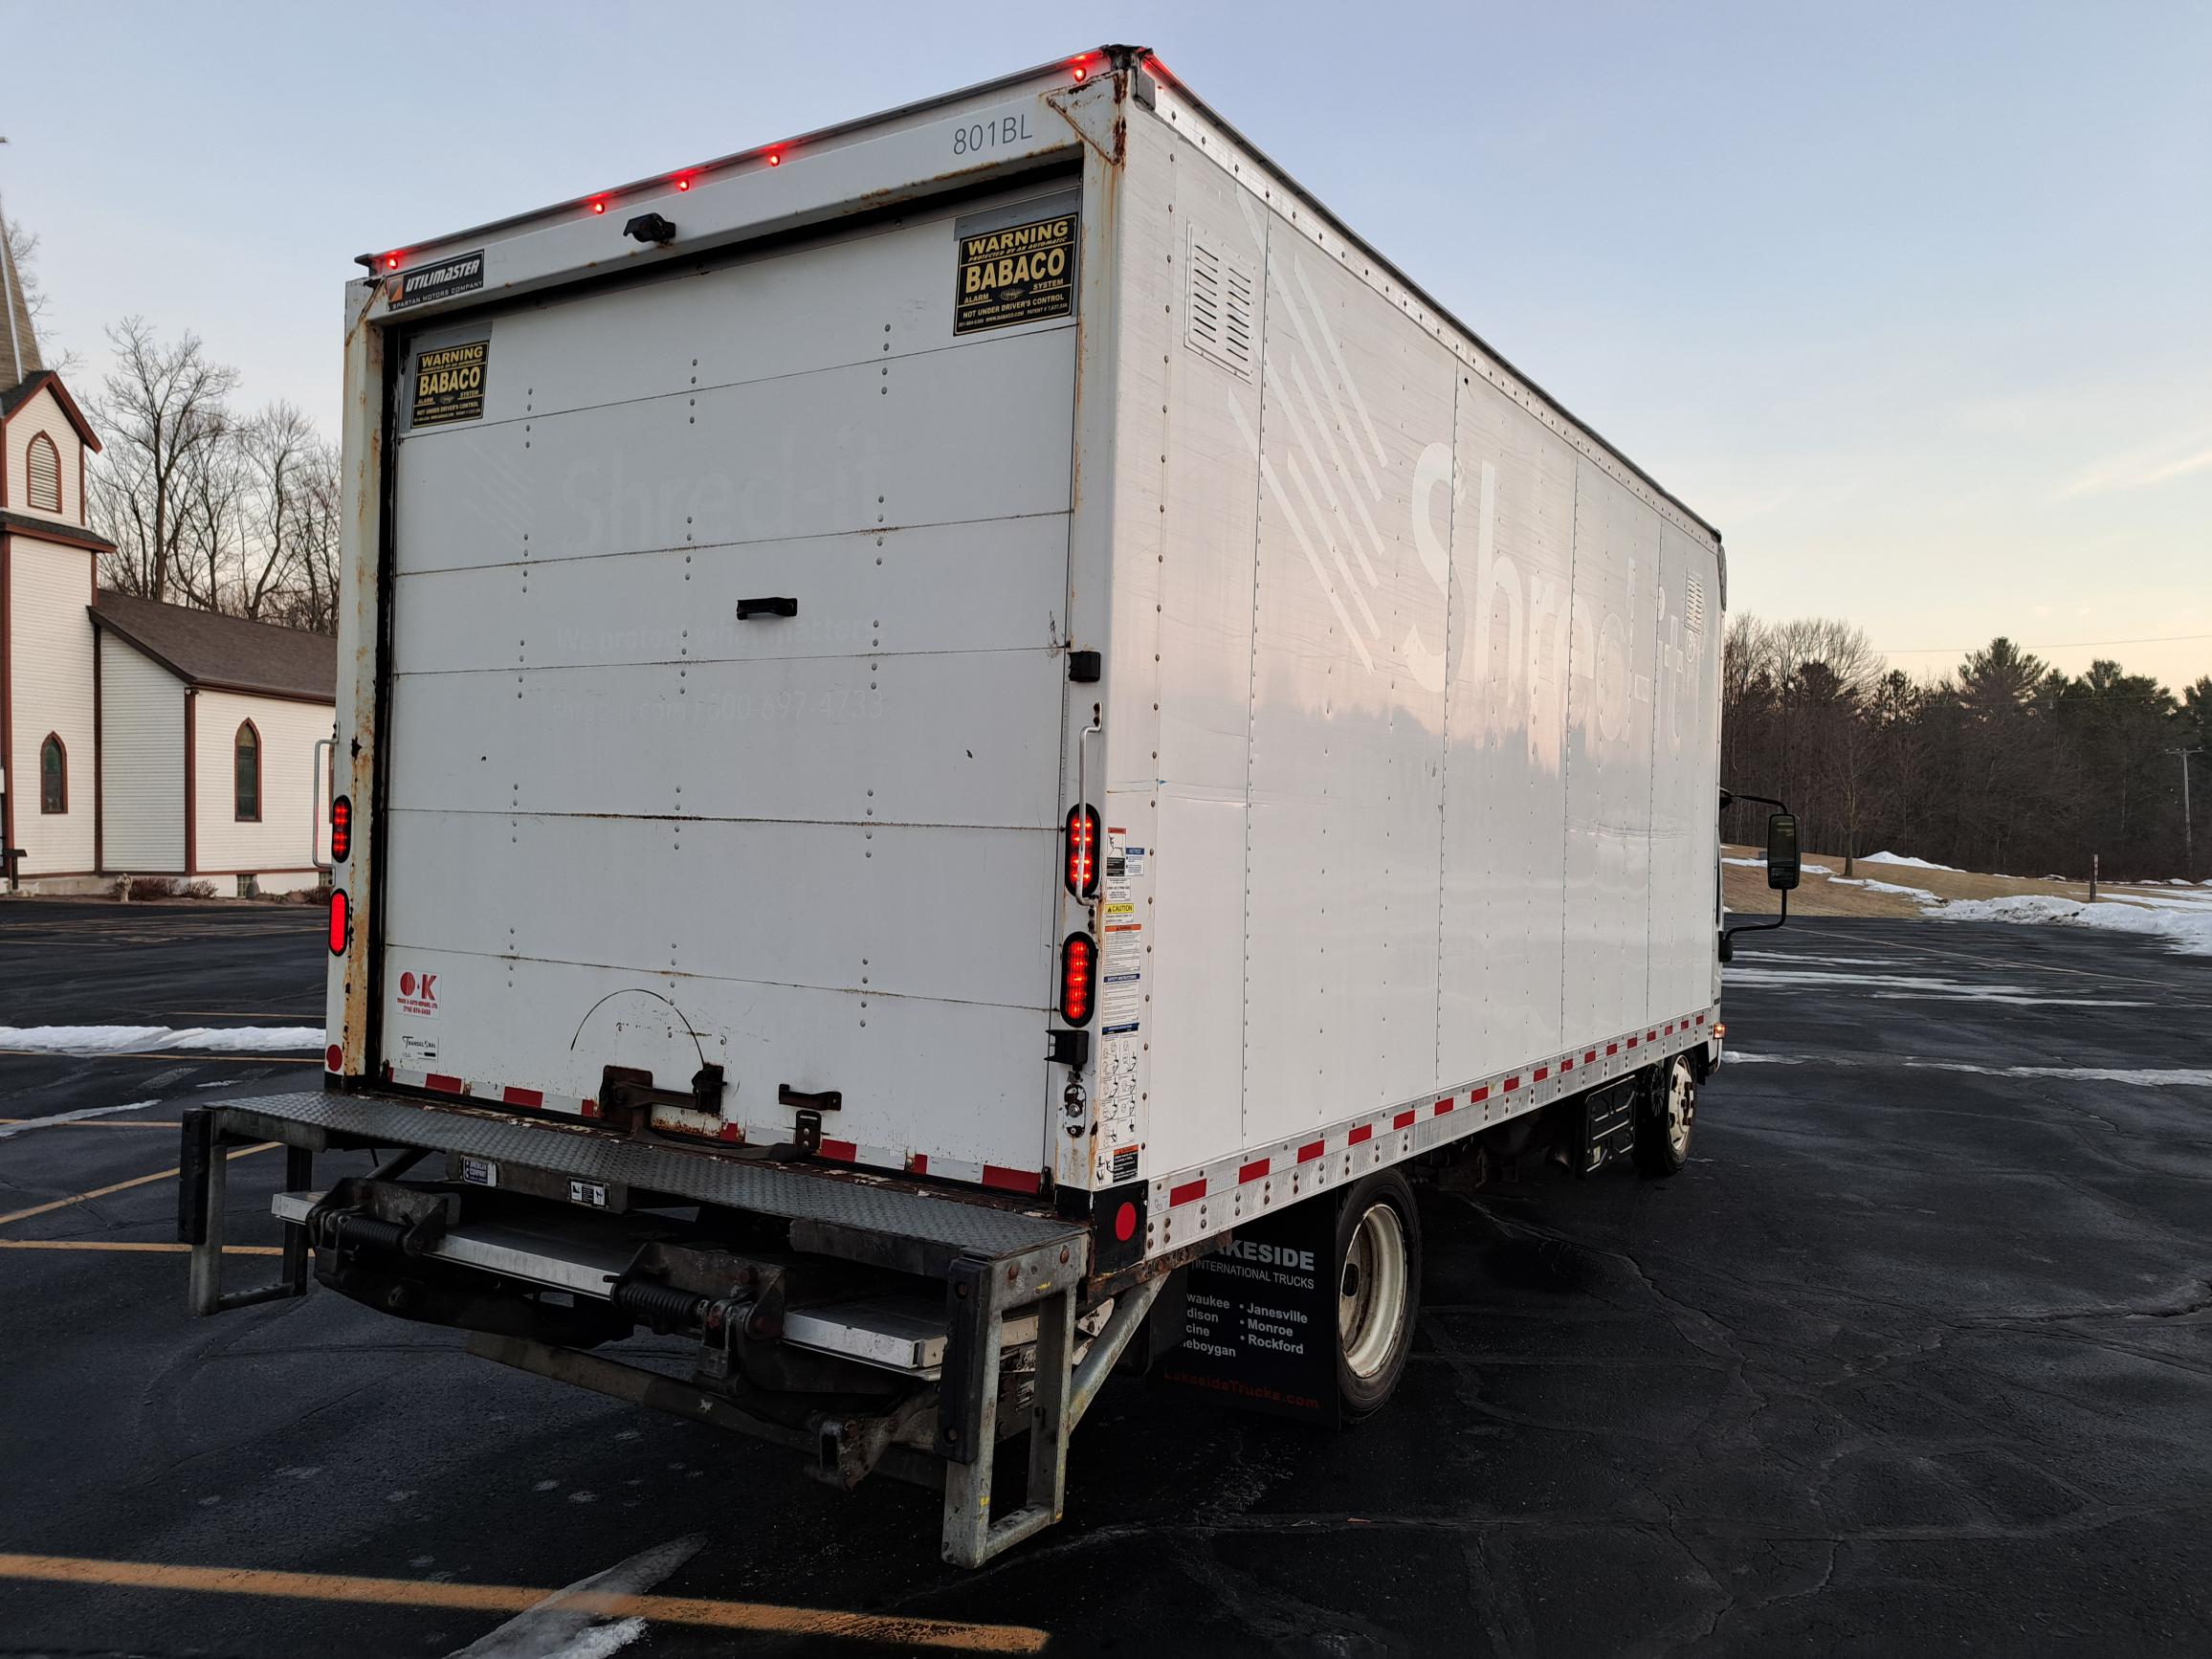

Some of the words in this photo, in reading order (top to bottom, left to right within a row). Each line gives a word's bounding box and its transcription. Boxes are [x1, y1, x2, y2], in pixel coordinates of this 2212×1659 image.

[954, 114, 1032, 154] 801BL
[968, 221, 1068, 255] WARNING
[405, 258, 480, 293] UTILIMASTER
[965, 247, 1066, 294] BABACO
[392, 298, 421, 310] SPARTAN
[422, 289, 450, 301] MOTORS
[451, 280, 483, 295] COMPANY
[1033, 278, 1064, 291] SYSTEM
[962, 310, 976, 320] NOT
[978, 305, 1001, 316] UNDER
[1001, 300, 1031, 312] DRIVER'S
[1032, 294, 1064, 306] CONTROL
[964, 293, 989, 304] ALARM
[422, 345, 483, 368] WARNING
[419, 366, 481, 397] BABACO
[1112, 904, 1133, 913] CAUTION
[1272, 1272, 1315, 1290] TRUCKS
[1247, 1302, 1308, 1324] Janesville
[1248, 1317, 1294, 1337] Monroe
[1248, 1334, 1304, 1356] Rockford
[1163, 1365, 1320, 1408] LakesideTrucks.com
